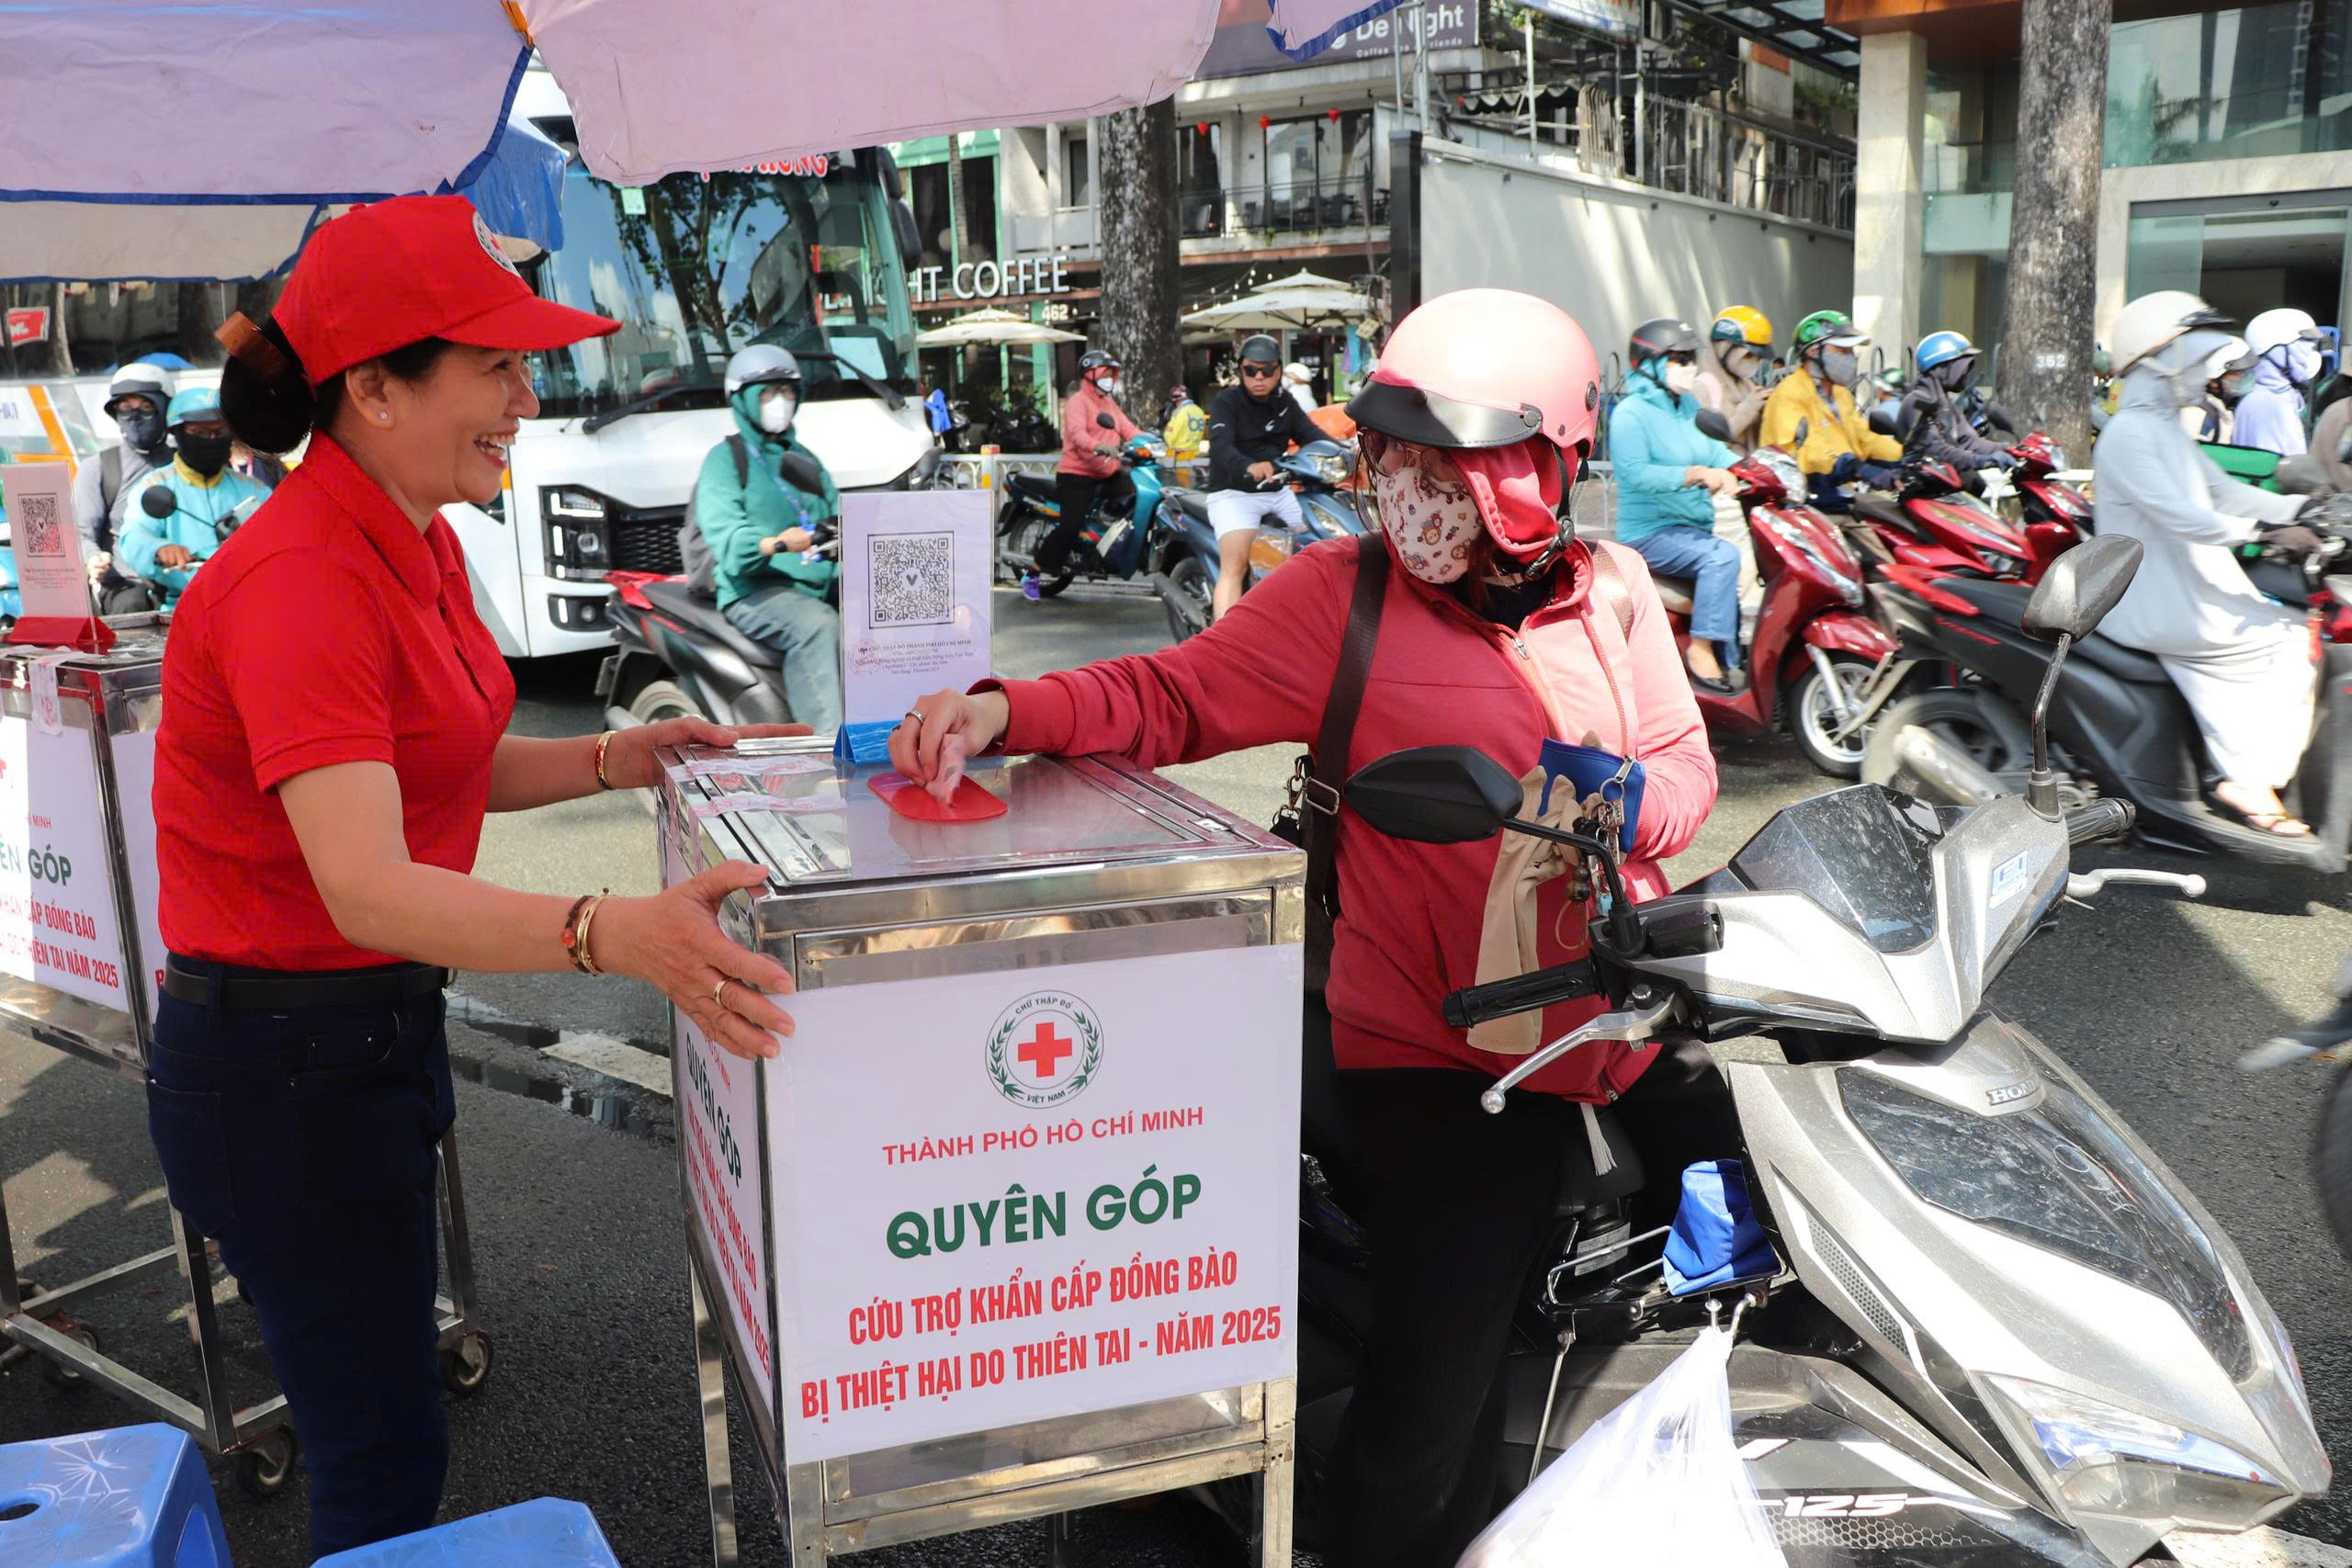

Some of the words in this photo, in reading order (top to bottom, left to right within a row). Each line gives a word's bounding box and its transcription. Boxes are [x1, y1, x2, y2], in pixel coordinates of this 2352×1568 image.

[1396, 4, 1464, 39] Nght
[952, 255, 1070, 299] COFFEE
[1042, 304, 1069, 321] 462
[28, 843, 72, 886] GÓP
[50, 945, 66, 972] TAI
[66, 948, 91, 980] NĂM
[92, 958, 119, 988] 2025
[1015, 998, 1033, 1015] CHỮ
[1035, 996, 1057, 1007] THẬP
[1059, 998, 1074, 1010] ĐỎ
[686, 1031, 717, 1133] QUYÊN
[718, 1105, 742, 1189] GÓP
[1027, 1094, 1046, 1104] VIỆT
[1047, 1090, 1066, 1102] NAM
[882, 1136, 974, 1165] THÀNH
[983, 1123, 1038, 1152] PHỐ
[1046, 1118, 1083, 1145] HỒ
[1091, 1111, 1133, 1138] CHÍ
[1142, 1106, 1204, 1133] MINH
[887, 1183, 1067, 1259] QUYÊN
[1086, 1163, 1202, 1231] GÓP
[849, 1296, 903, 1345] CỨU
[911, 1287, 962, 1337] TRỢ
[970, 1267, 1043, 1325] KHẨN
[1051, 1259, 1102, 1312] CẤP
[1110, 1251, 1180, 1303] ĐỒNG
[1188, 1247, 1238, 1292] BÀO
[801, 1379, 829, 1424] BỊ
[836, 1359, 910, 1412] THIỆT
[918, 1355, 962, 1402] HẠI
[970, 1348, 1005, 1388] DO
[1012, 1331, 1087, 1381] THIÊN
[1094, 1327, 1130, 1367] TAI
[1138, 1340, 1148, 1348] -
[1157, 1311, 1214, 1356] NĂM
[1221, 1305, 1282, 1346] 2025
[1783, 1494, 1908, 1517] 125
